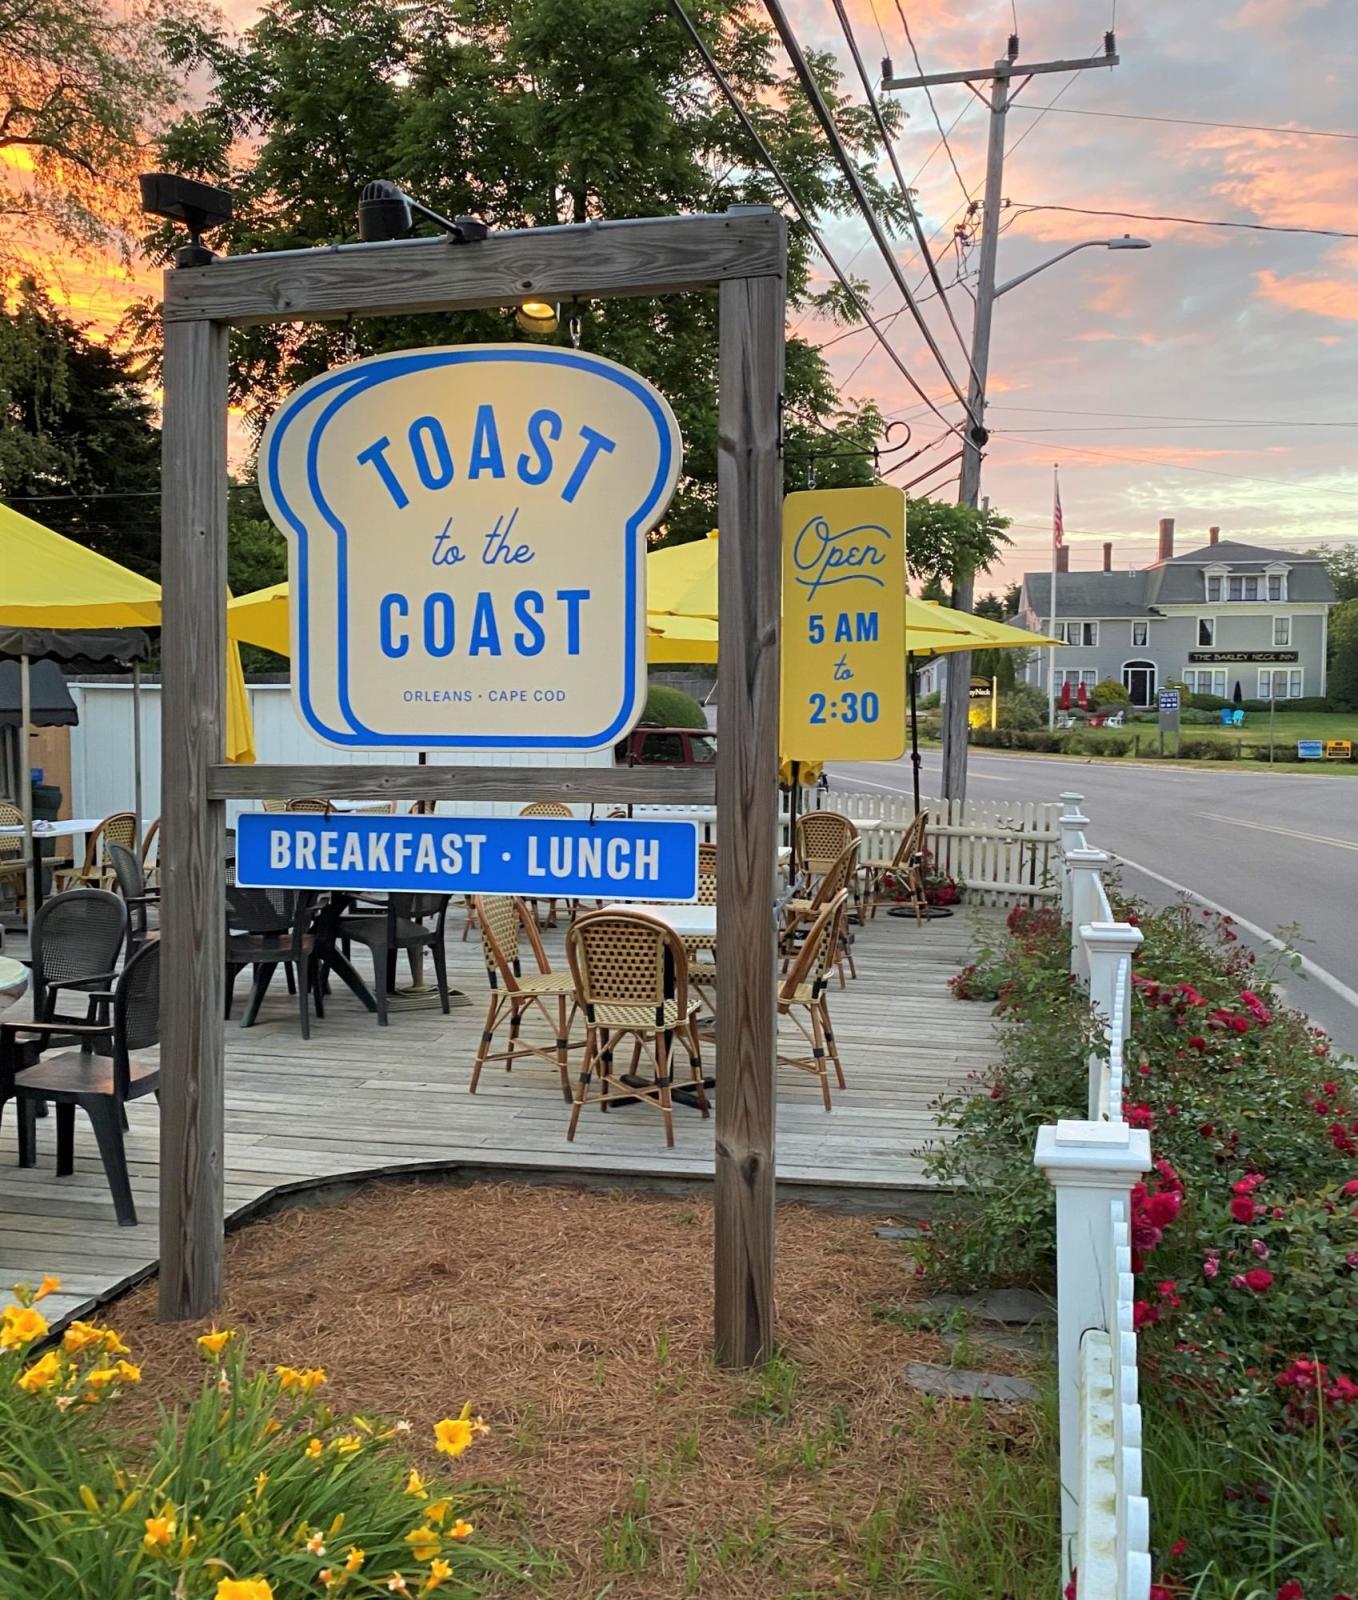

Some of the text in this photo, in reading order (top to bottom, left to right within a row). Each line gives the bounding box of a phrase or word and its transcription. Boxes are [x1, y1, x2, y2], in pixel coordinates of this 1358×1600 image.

[357, 404, 616, 509] TOAST
[432, 507, 535, 567] to the
[794, 515, 891, 601] Open
[379, 589, 591, 658] COAST
[808, 612, 879, 644] 5 AM
[833, 653, 854, 681] to
[403, 690, 473, 702] ORLEANS
[488, 690, 528, 702] CAPE
[533, 690, 566, 702] COD
[809, 692, 880, 724] 2:30
[269, 830, 487, 875] BREAKFAST
[527, 836, 660, 881] LUNCH
